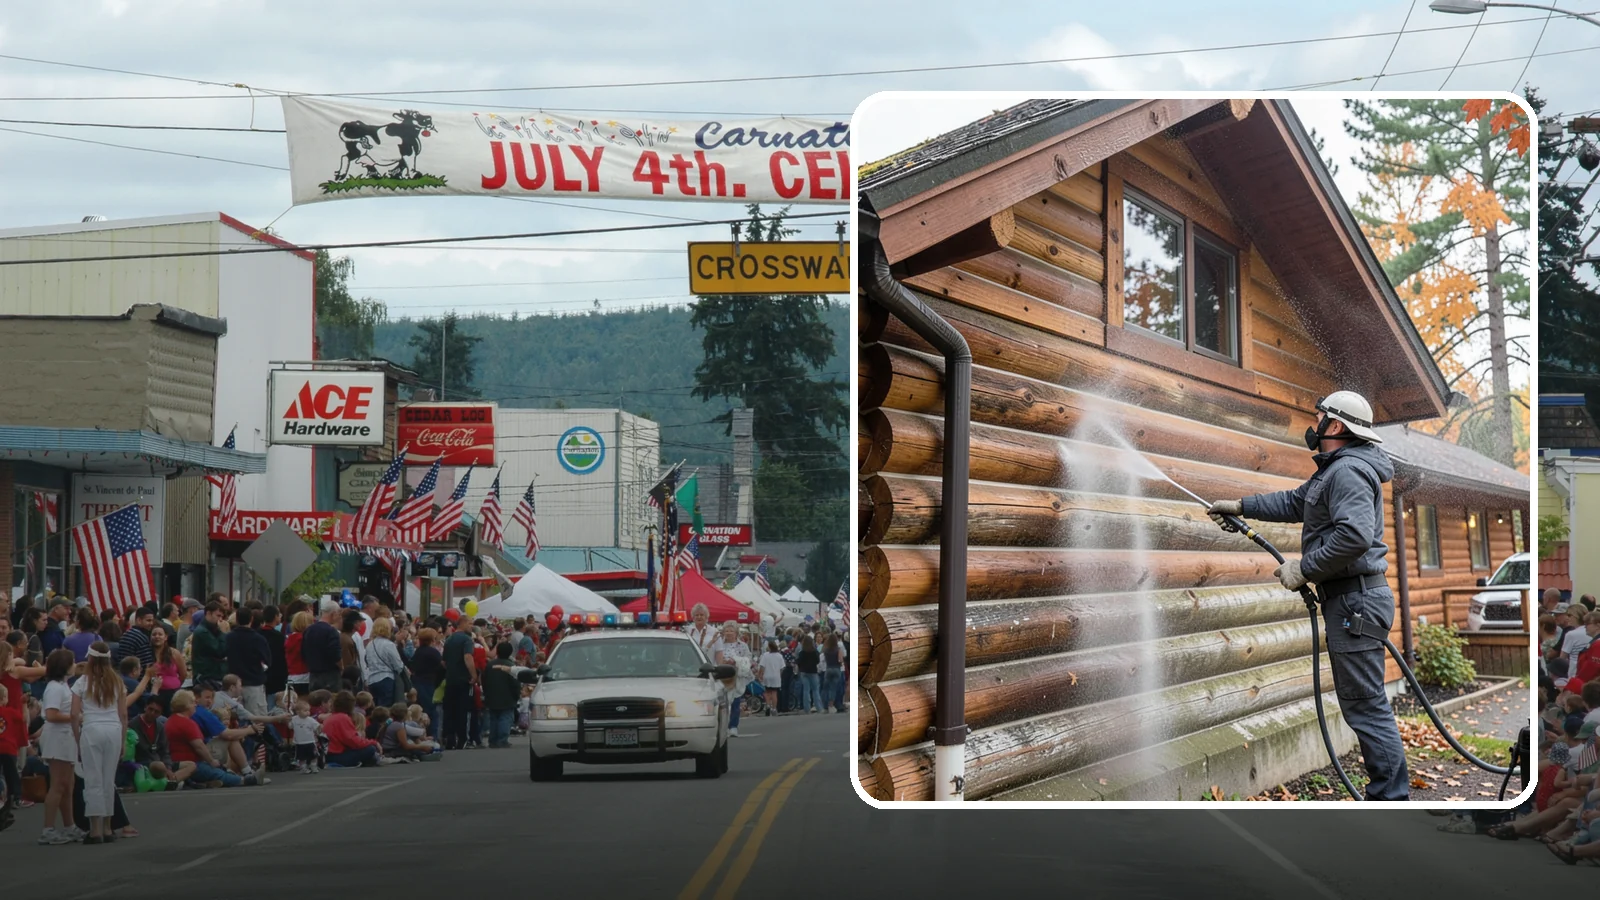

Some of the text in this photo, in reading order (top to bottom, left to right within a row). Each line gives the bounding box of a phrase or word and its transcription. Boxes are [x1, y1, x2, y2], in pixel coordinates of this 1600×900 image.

[481, 141, 605, 192] JULY
[632, 150, 746, 197] 4th.
[697, 254, 850, 280] CROSSWA
[283, 380, 373, 420] ACE
[405, 409, 485, 422] CEDAR LOG
[283, 421, 371, 436] Hardware
[95, 485, 124, 494] Vincent
[126, 486, 136, 495] de
[137, 486, 155, 495] Paul
[688, 526, 741, 534] CRNATION
[699, 535, 730, 543] GLASS
